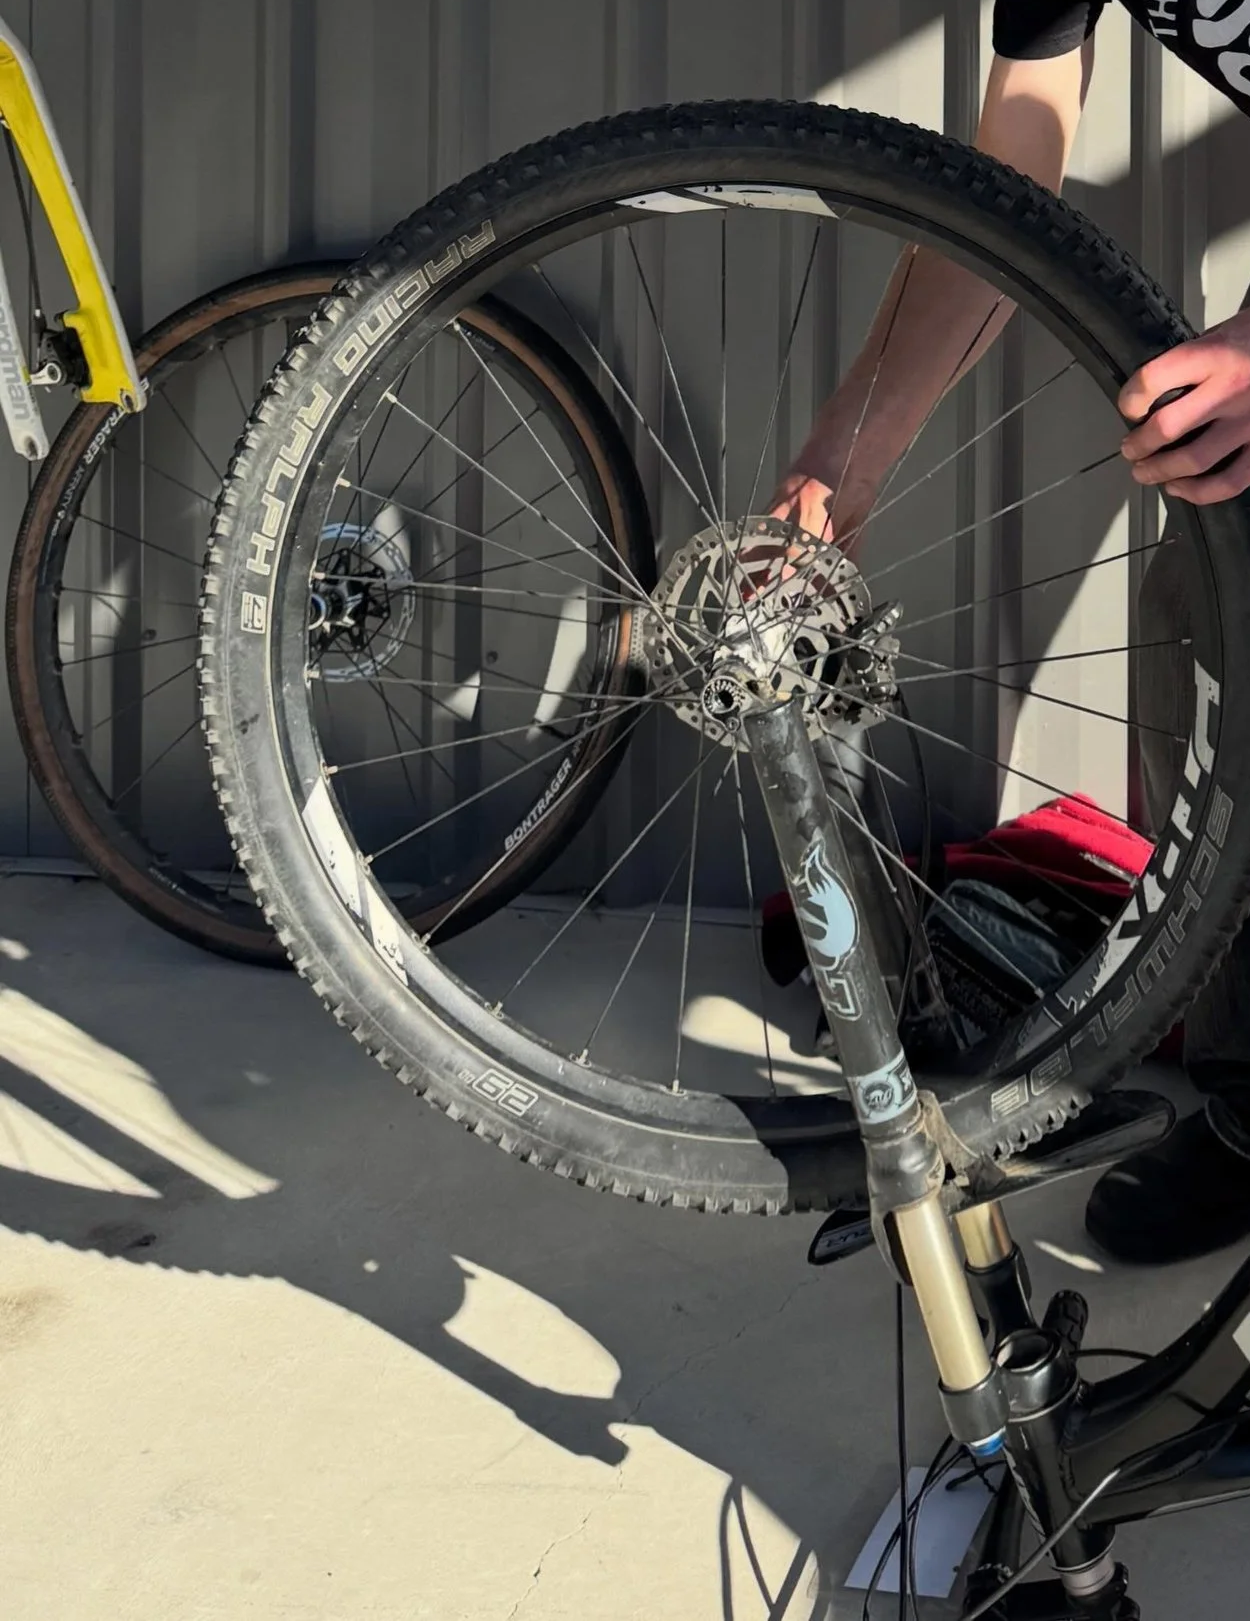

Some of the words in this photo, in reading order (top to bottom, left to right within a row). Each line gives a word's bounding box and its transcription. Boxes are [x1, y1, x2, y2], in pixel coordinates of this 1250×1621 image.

[331, 218, 498, 377] RACING
[245, 382, 333, 577] RALPH
[503, 758, 573, 853] BONTRAGER
[989, 782, 1236, 1124] SCHWALBE
